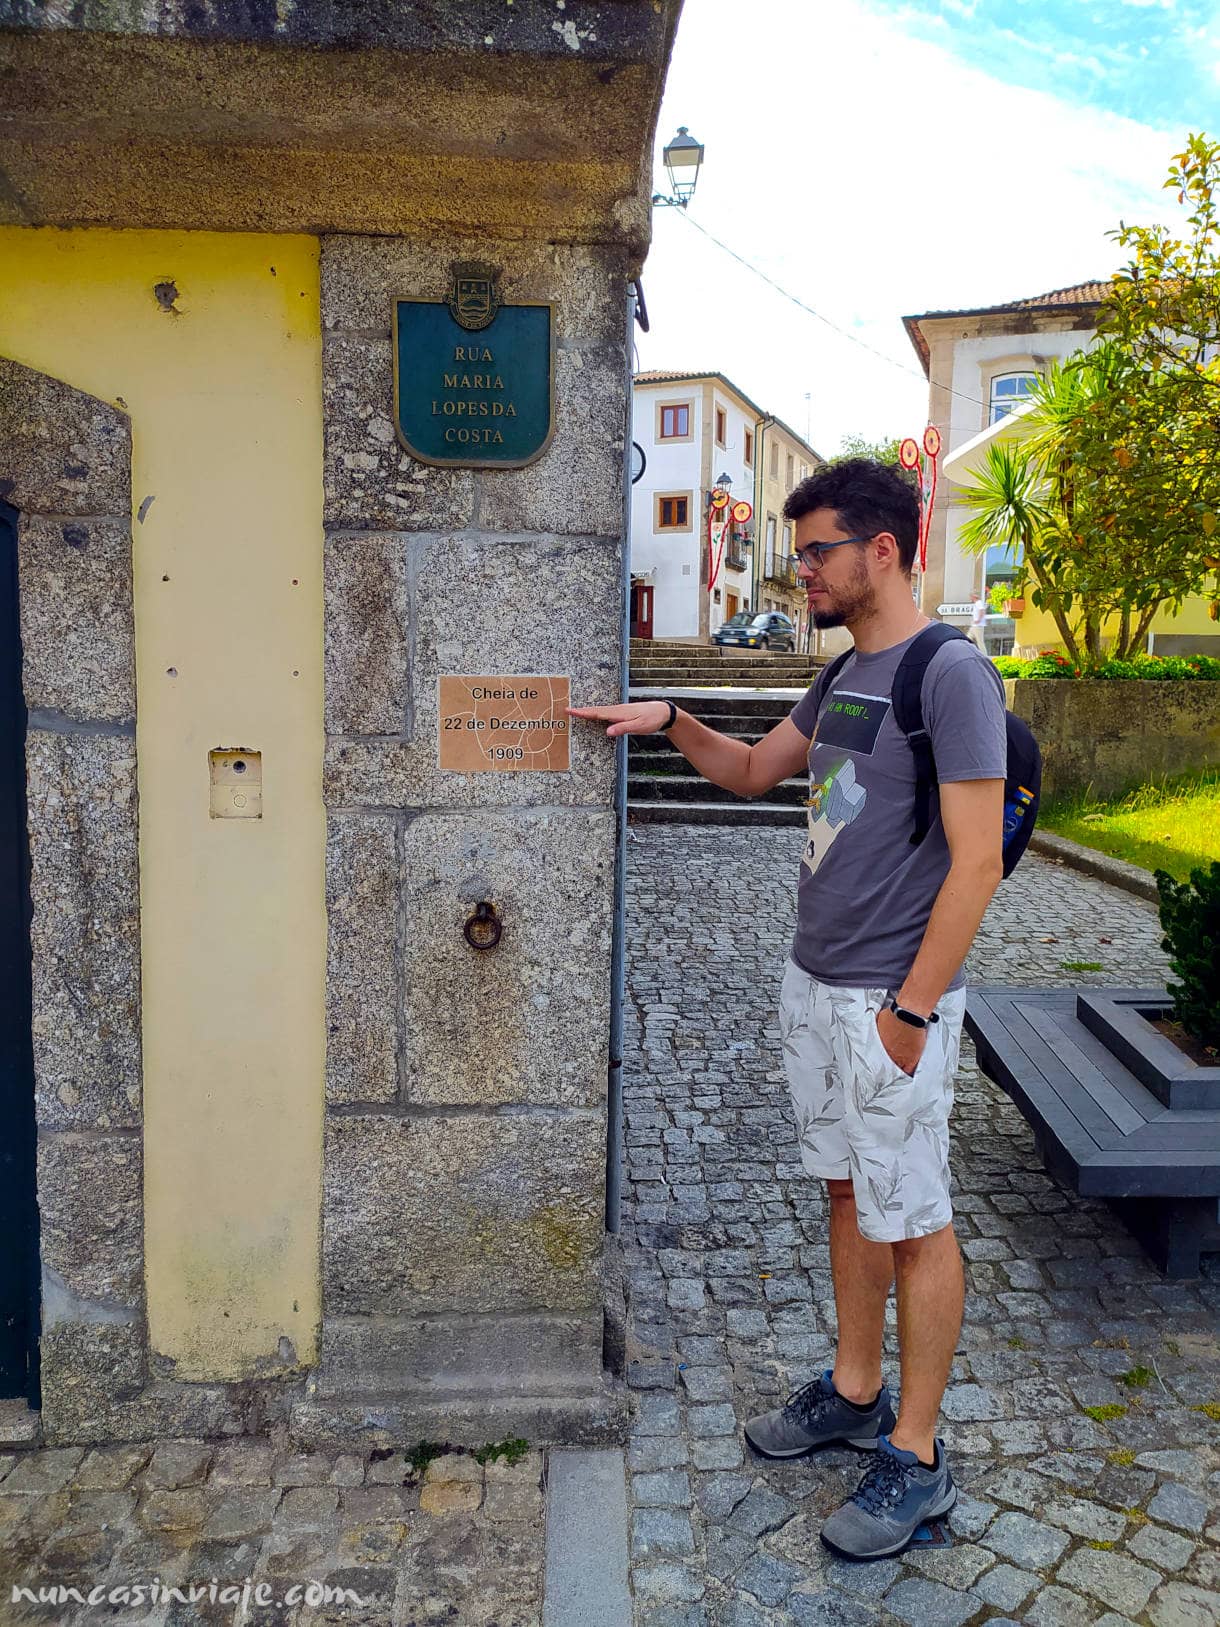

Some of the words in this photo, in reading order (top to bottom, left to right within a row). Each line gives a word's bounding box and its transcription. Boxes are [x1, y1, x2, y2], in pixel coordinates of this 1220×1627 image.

[454, 347, 494, 361] RUA
[443, 374, 505, 389] MARIA
[444, 428, 505, 443] COSTA
[472, 687, 515, 700] Cheia
[519, 687, 538, 700] de
[444, 717, 462, 731] 22
[466, 717, 486, 730] de
[490, 717, 566, 730] Dezembro
[487, 747, 525, 761] 1909
